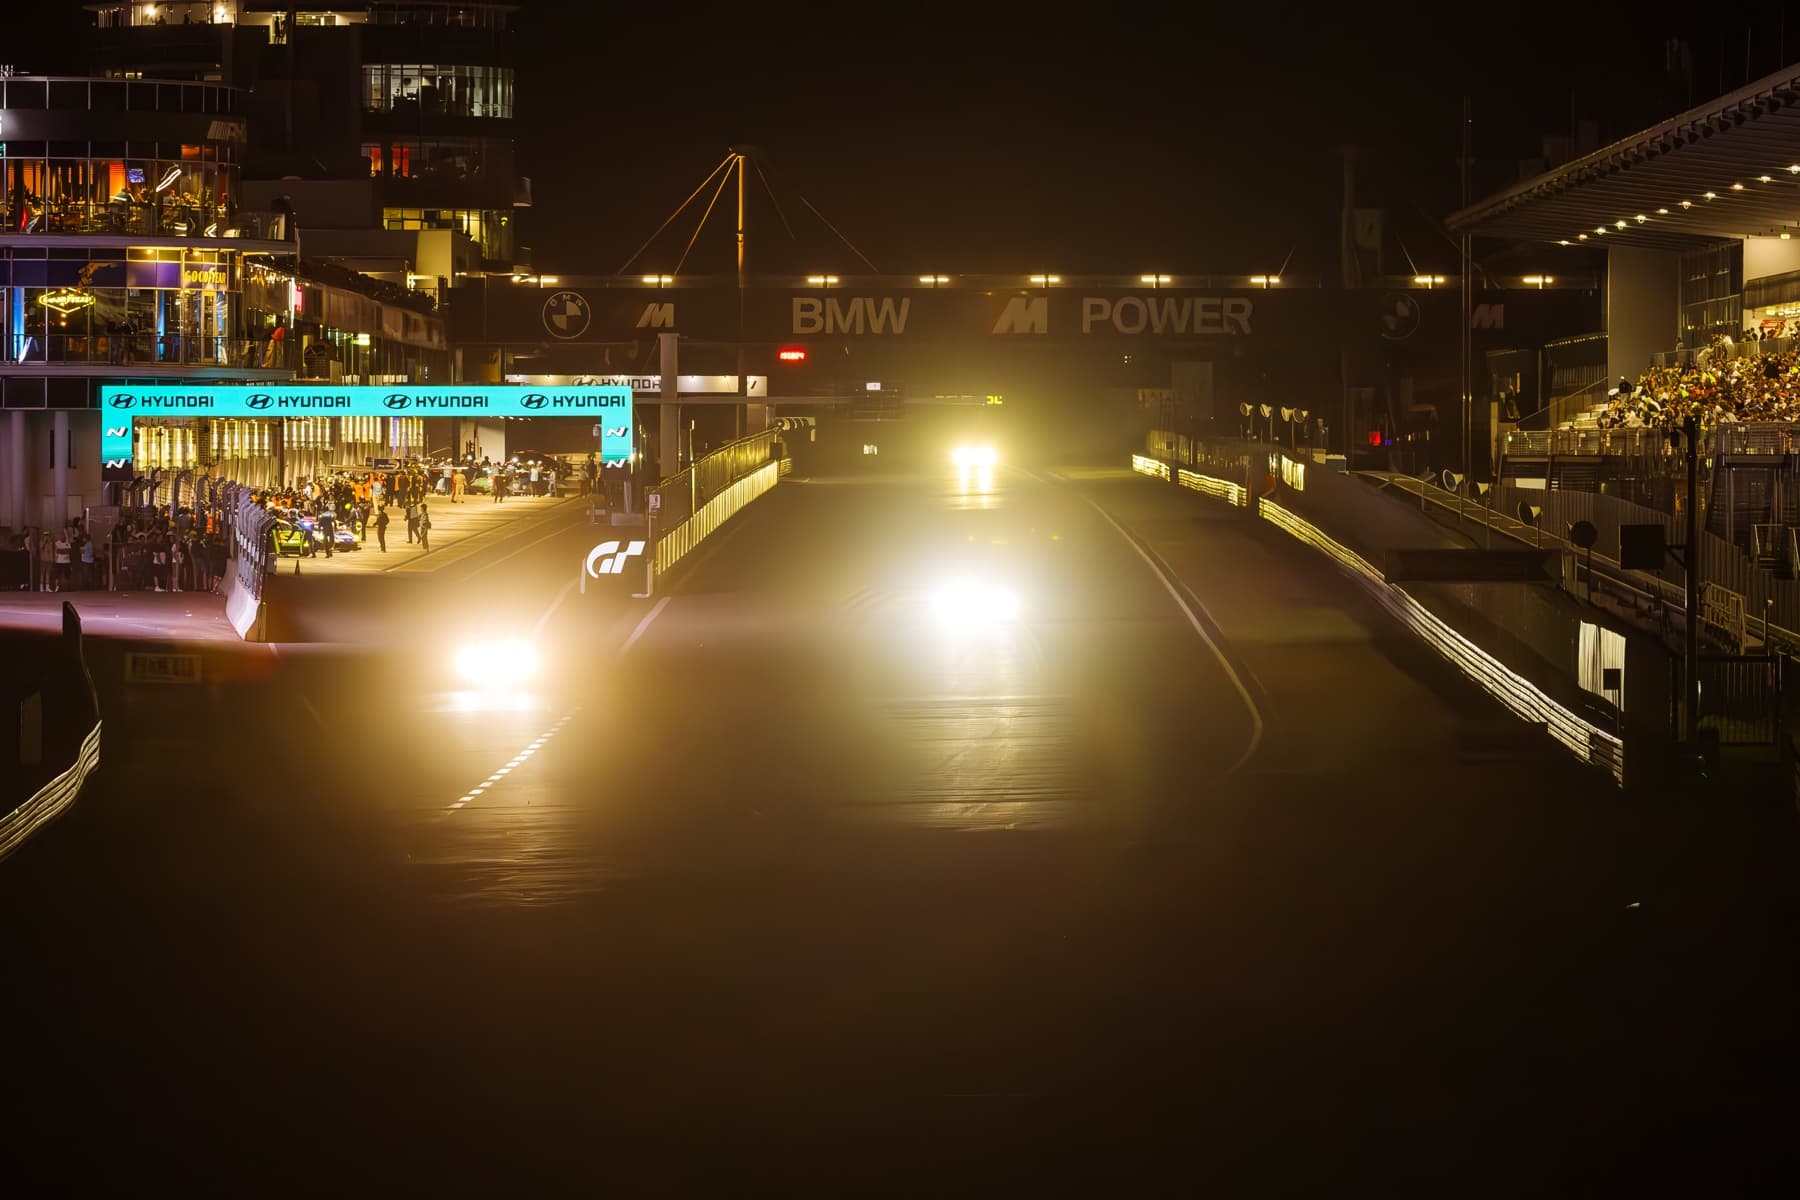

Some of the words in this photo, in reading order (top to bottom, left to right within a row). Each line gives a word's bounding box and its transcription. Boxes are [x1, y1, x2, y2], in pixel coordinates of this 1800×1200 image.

[792, 297, 911, 335] BMW
[1082, 296, 1254, 335] POWER
[141, 395, 214, 408] HYUNDAI
[278, 395, 351, 408] HYUNDAI
[415, 395, 489, 408] HYUNDAI
[553, 395, 626, 408] HYUNDAI
